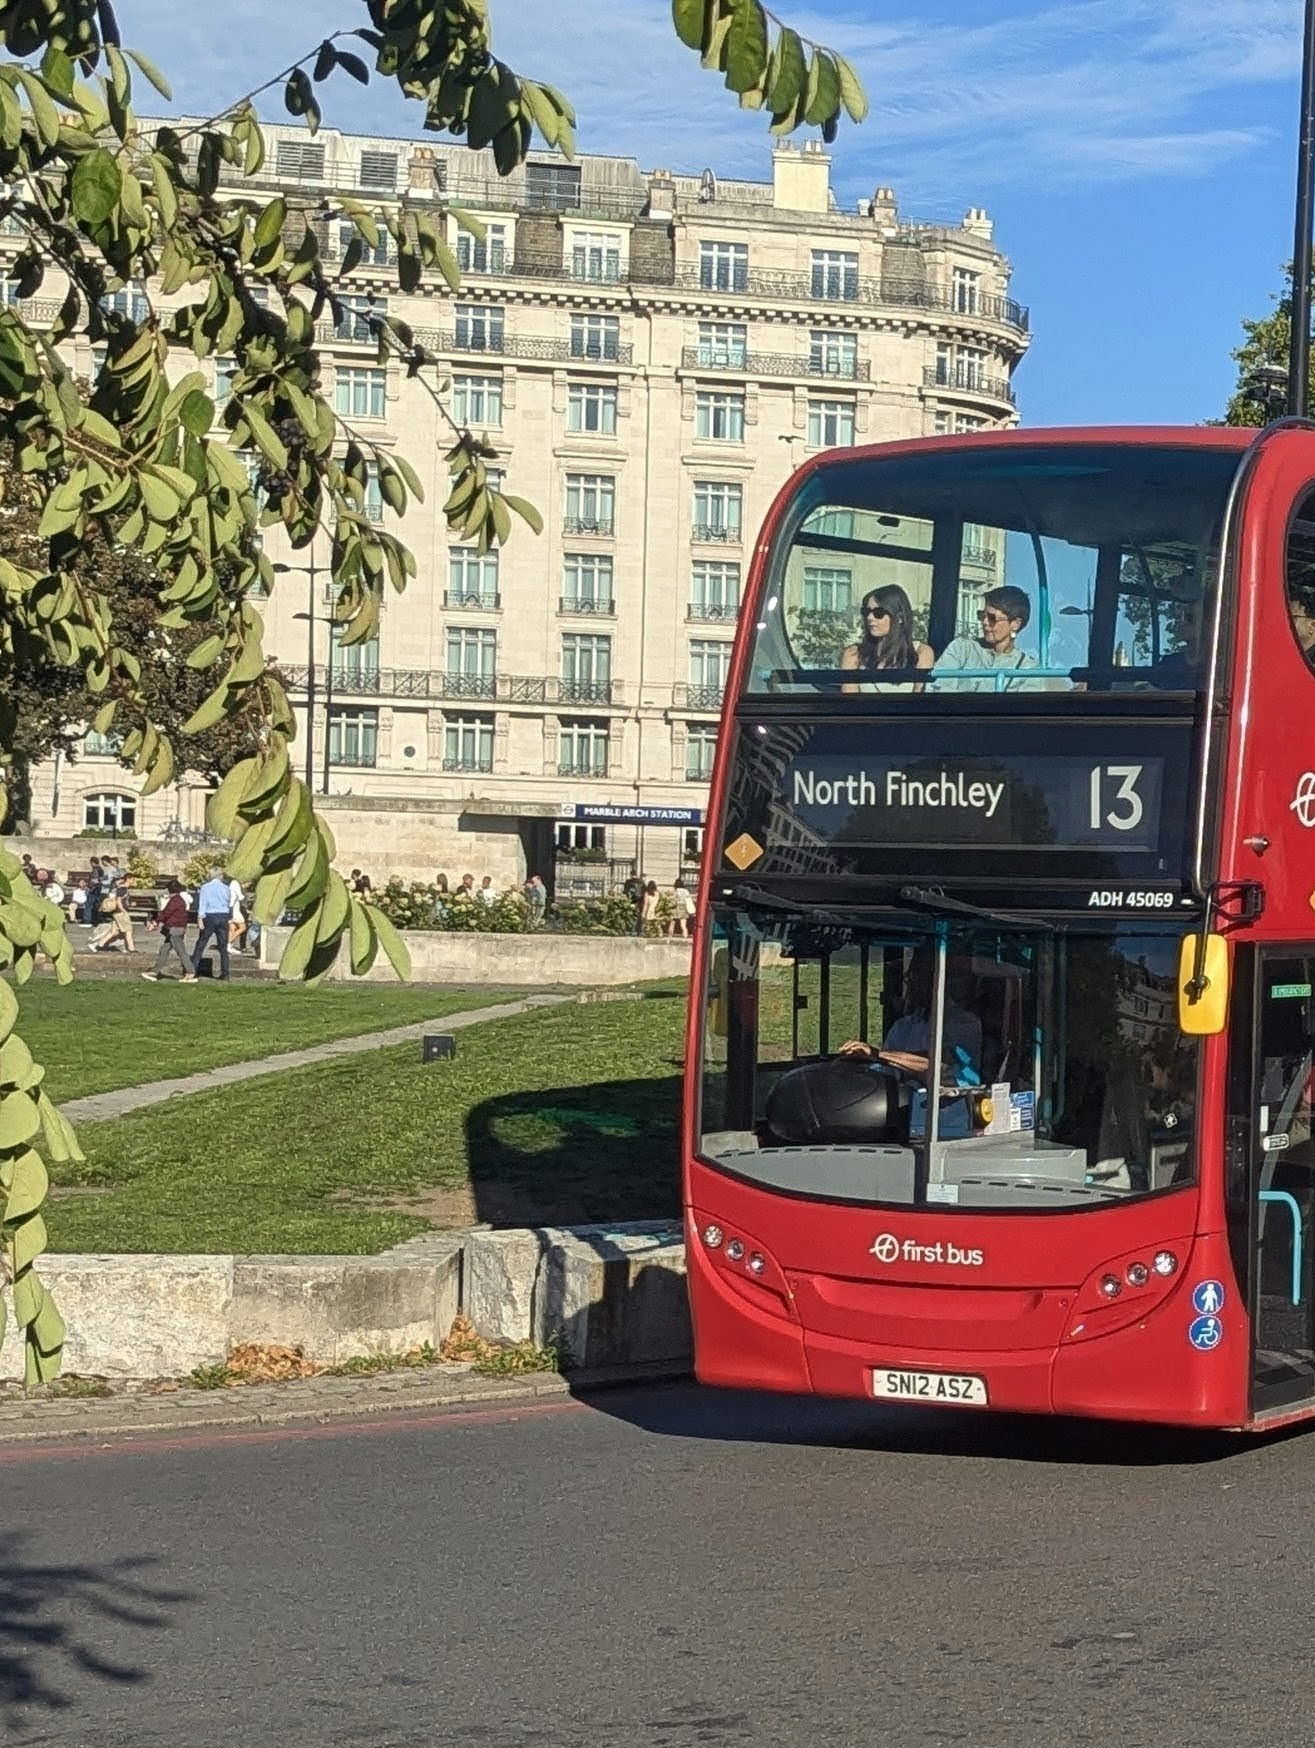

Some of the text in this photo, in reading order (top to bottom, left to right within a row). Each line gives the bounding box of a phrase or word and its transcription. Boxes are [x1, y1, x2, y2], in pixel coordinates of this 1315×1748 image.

[793, 771, 1005, 818] North Finchley
[1090, 764, 1144, 830] 13
[584, 807, 692, 820] MARBLE ARCH STATION
[1088, 890, 1174, 908] ADH 45069
[902, 1239, 984, 1265] first bus
[886, 1373, 973, 1399] SN12 ASZ
